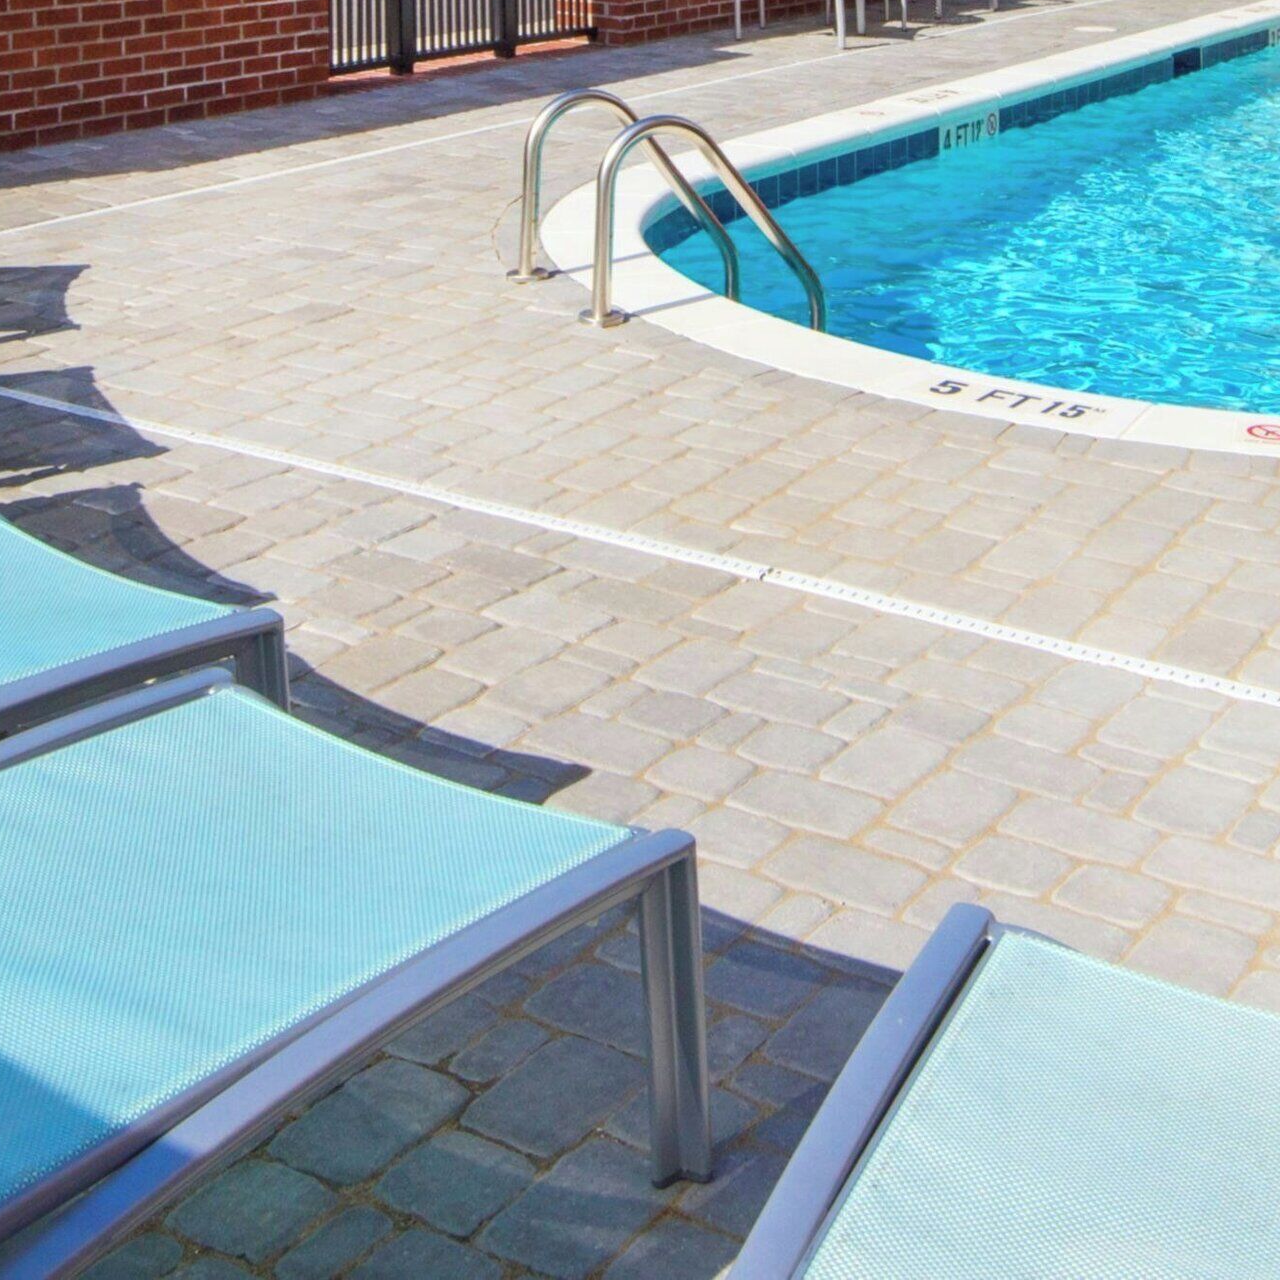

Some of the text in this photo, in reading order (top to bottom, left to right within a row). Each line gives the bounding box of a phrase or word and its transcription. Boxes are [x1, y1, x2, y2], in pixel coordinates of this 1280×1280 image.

[956, 122, 970, 148] FT
[929, 380, 969, 395] 5
[976, 389, 1042, 409] FT
